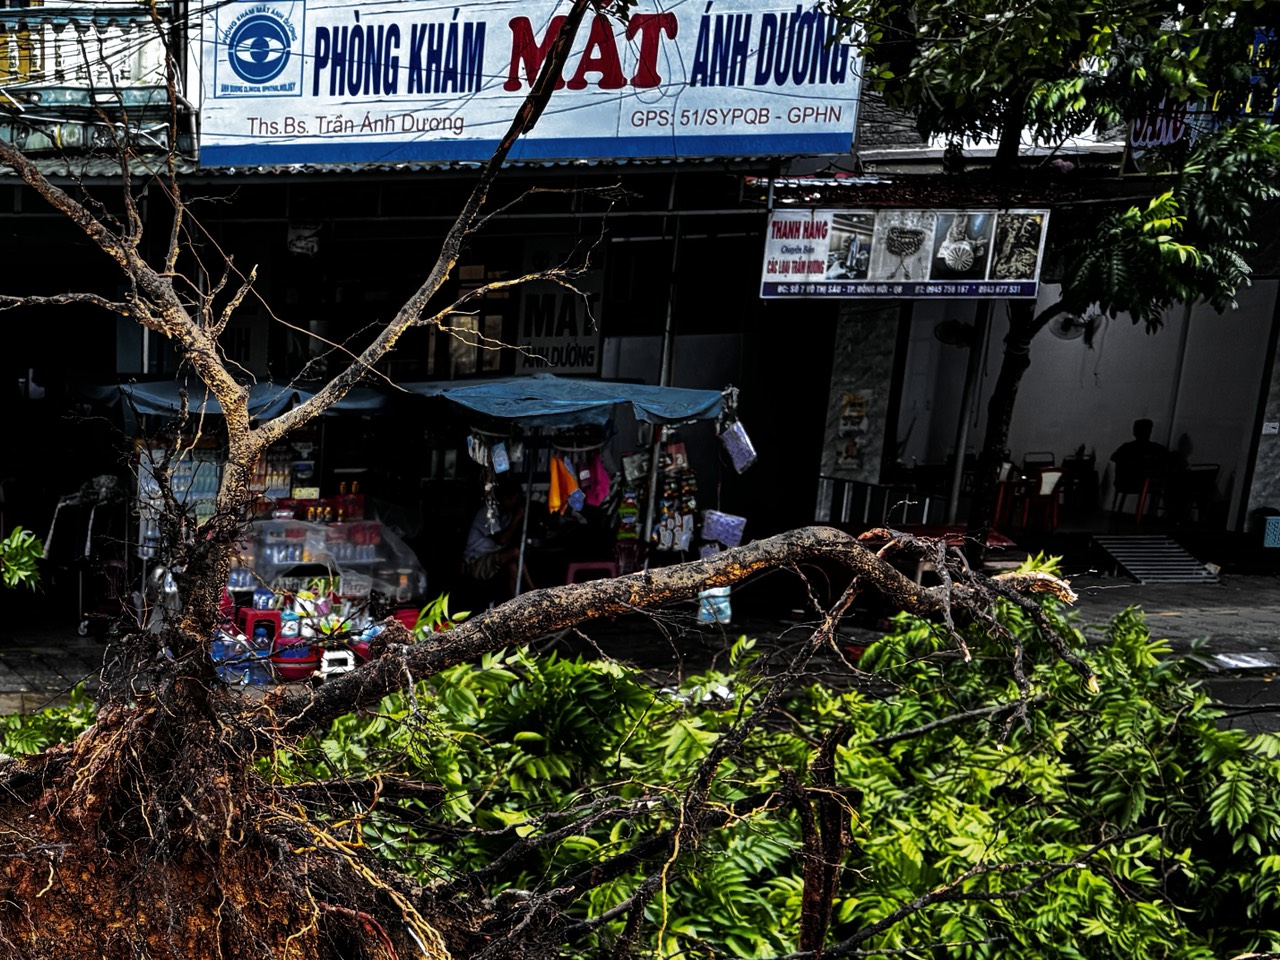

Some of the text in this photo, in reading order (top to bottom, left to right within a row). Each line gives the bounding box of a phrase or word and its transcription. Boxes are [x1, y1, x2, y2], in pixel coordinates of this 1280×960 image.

[312, 10, 401, 97] PHÒNG
[407, 8, 487, 95] KHÁM
[690, 1, 753, 88] ÁNH
[754, 4, 852, 87] DƯƠNG
[247, 111, 465, 135] Ths.Bs. Trần Ánh Dương
[631, 110, 673, 127] GPS:
[680, 108, 770, 126] 51/SYPQB
[787, 106, 842, 123] GPHN
[771, 221, 801, 240] THANH
